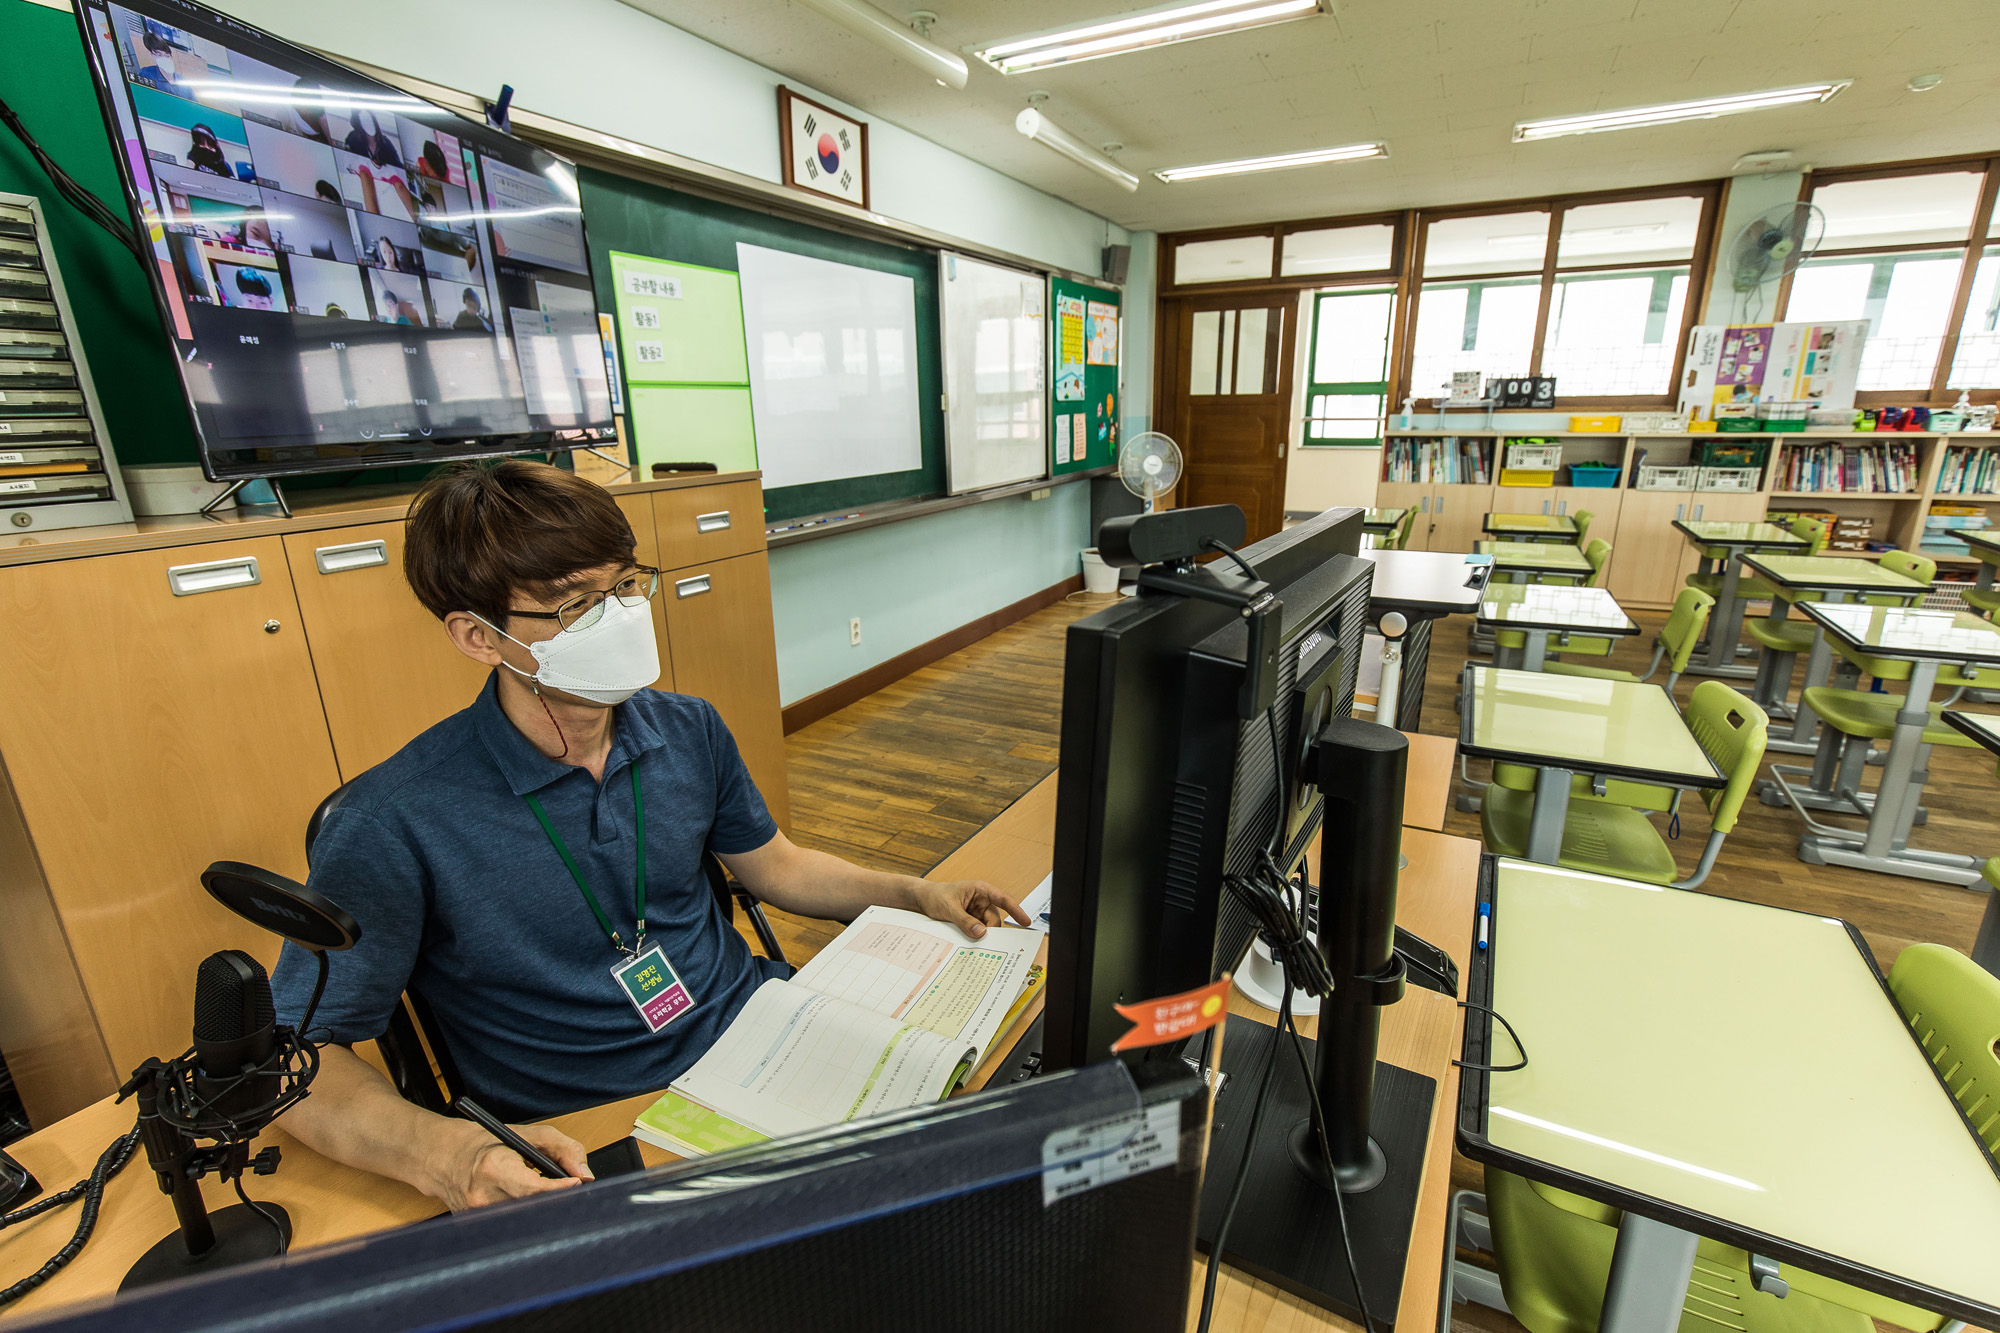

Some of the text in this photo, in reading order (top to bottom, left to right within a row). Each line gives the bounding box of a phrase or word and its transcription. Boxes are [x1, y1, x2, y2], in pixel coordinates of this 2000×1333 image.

[632, 277, 676, 297] 공부할 내용
[635, 312, 657, 327] 활동1
[639, 345, 662, 361] 활동2
[634, 964, 657, 983] 김명진
[641, 973, 663, 992] 선생님
